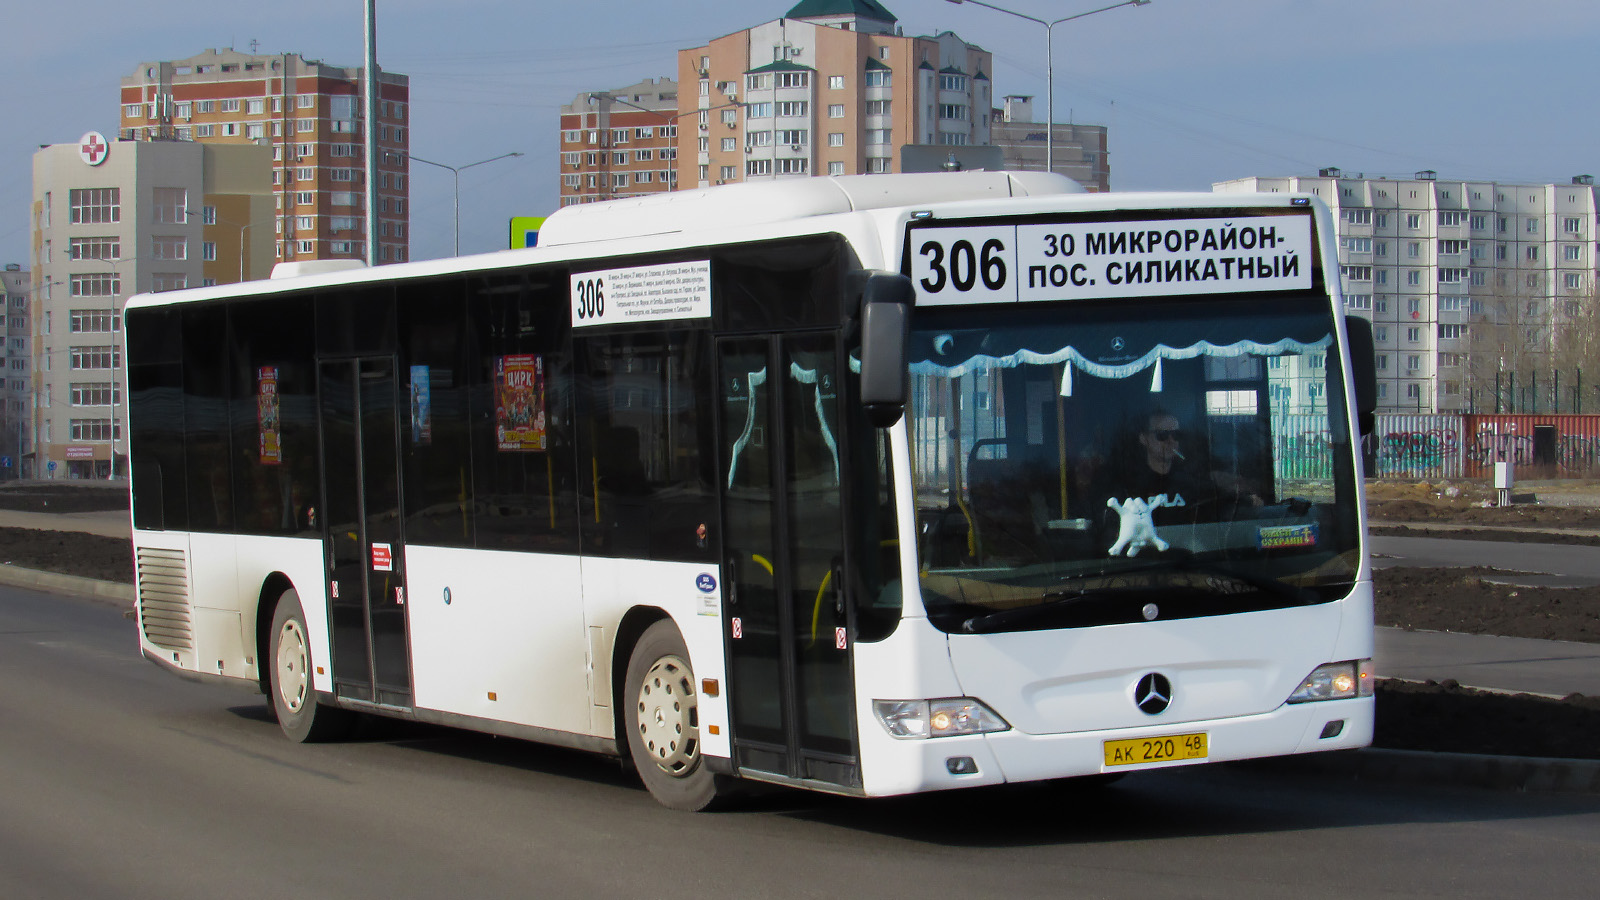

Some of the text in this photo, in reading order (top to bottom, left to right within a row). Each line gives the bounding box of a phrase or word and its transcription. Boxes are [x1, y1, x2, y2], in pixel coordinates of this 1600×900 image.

[1043, 222, 1285, 257] 30 МИКРОРАЙОН-
[919, 238, 1007, 294] 306
[1029, 249, 1300, 288] ПОС. СИЛИКАТНЫЙ
[577, 278, 604, 320] 306
[507, 371, 532, 387] ЦИРК
[1142, 739, 1174, 760] 220
[1185, 736, 1202, 750] 48
